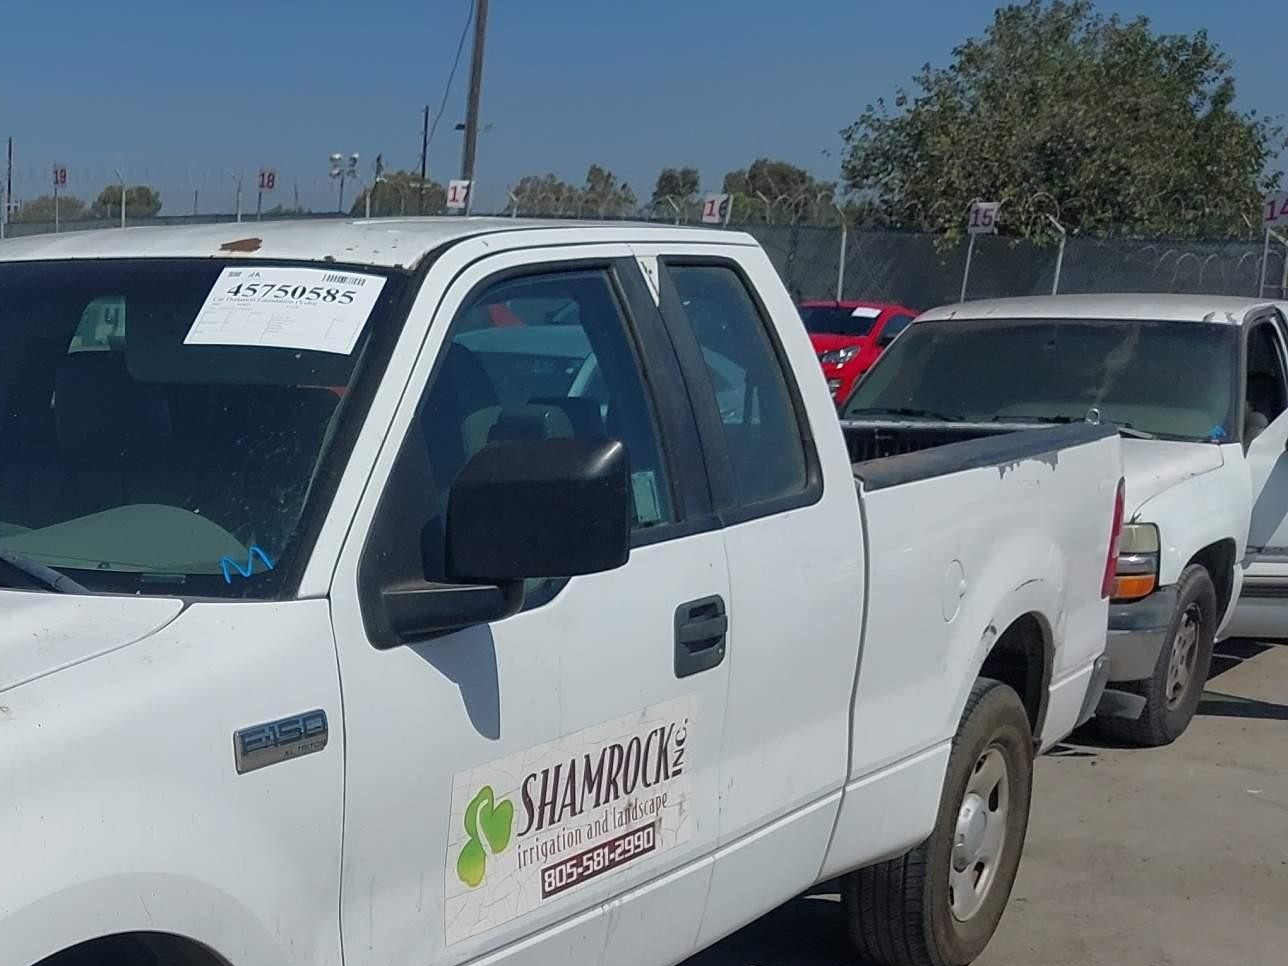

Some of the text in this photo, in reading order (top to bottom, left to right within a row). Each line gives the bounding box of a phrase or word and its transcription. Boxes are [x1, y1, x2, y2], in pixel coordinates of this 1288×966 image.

[53, 168, 67, 185] 19
[259, 172, 275, 189] 18
[449, 184, 470, 203] 17
[970, 208, 993, 228] 15
[226, 282, 357, 305] 45750585
[237, 711, 326, 757] F-150
[671, 717, 689, 778] INC.
[517, 722, 675, 837] SHAMROCK
[517, 791, 668, 870] irrigation and landscape
[543, 826, 654, 893] 805-581-2990
